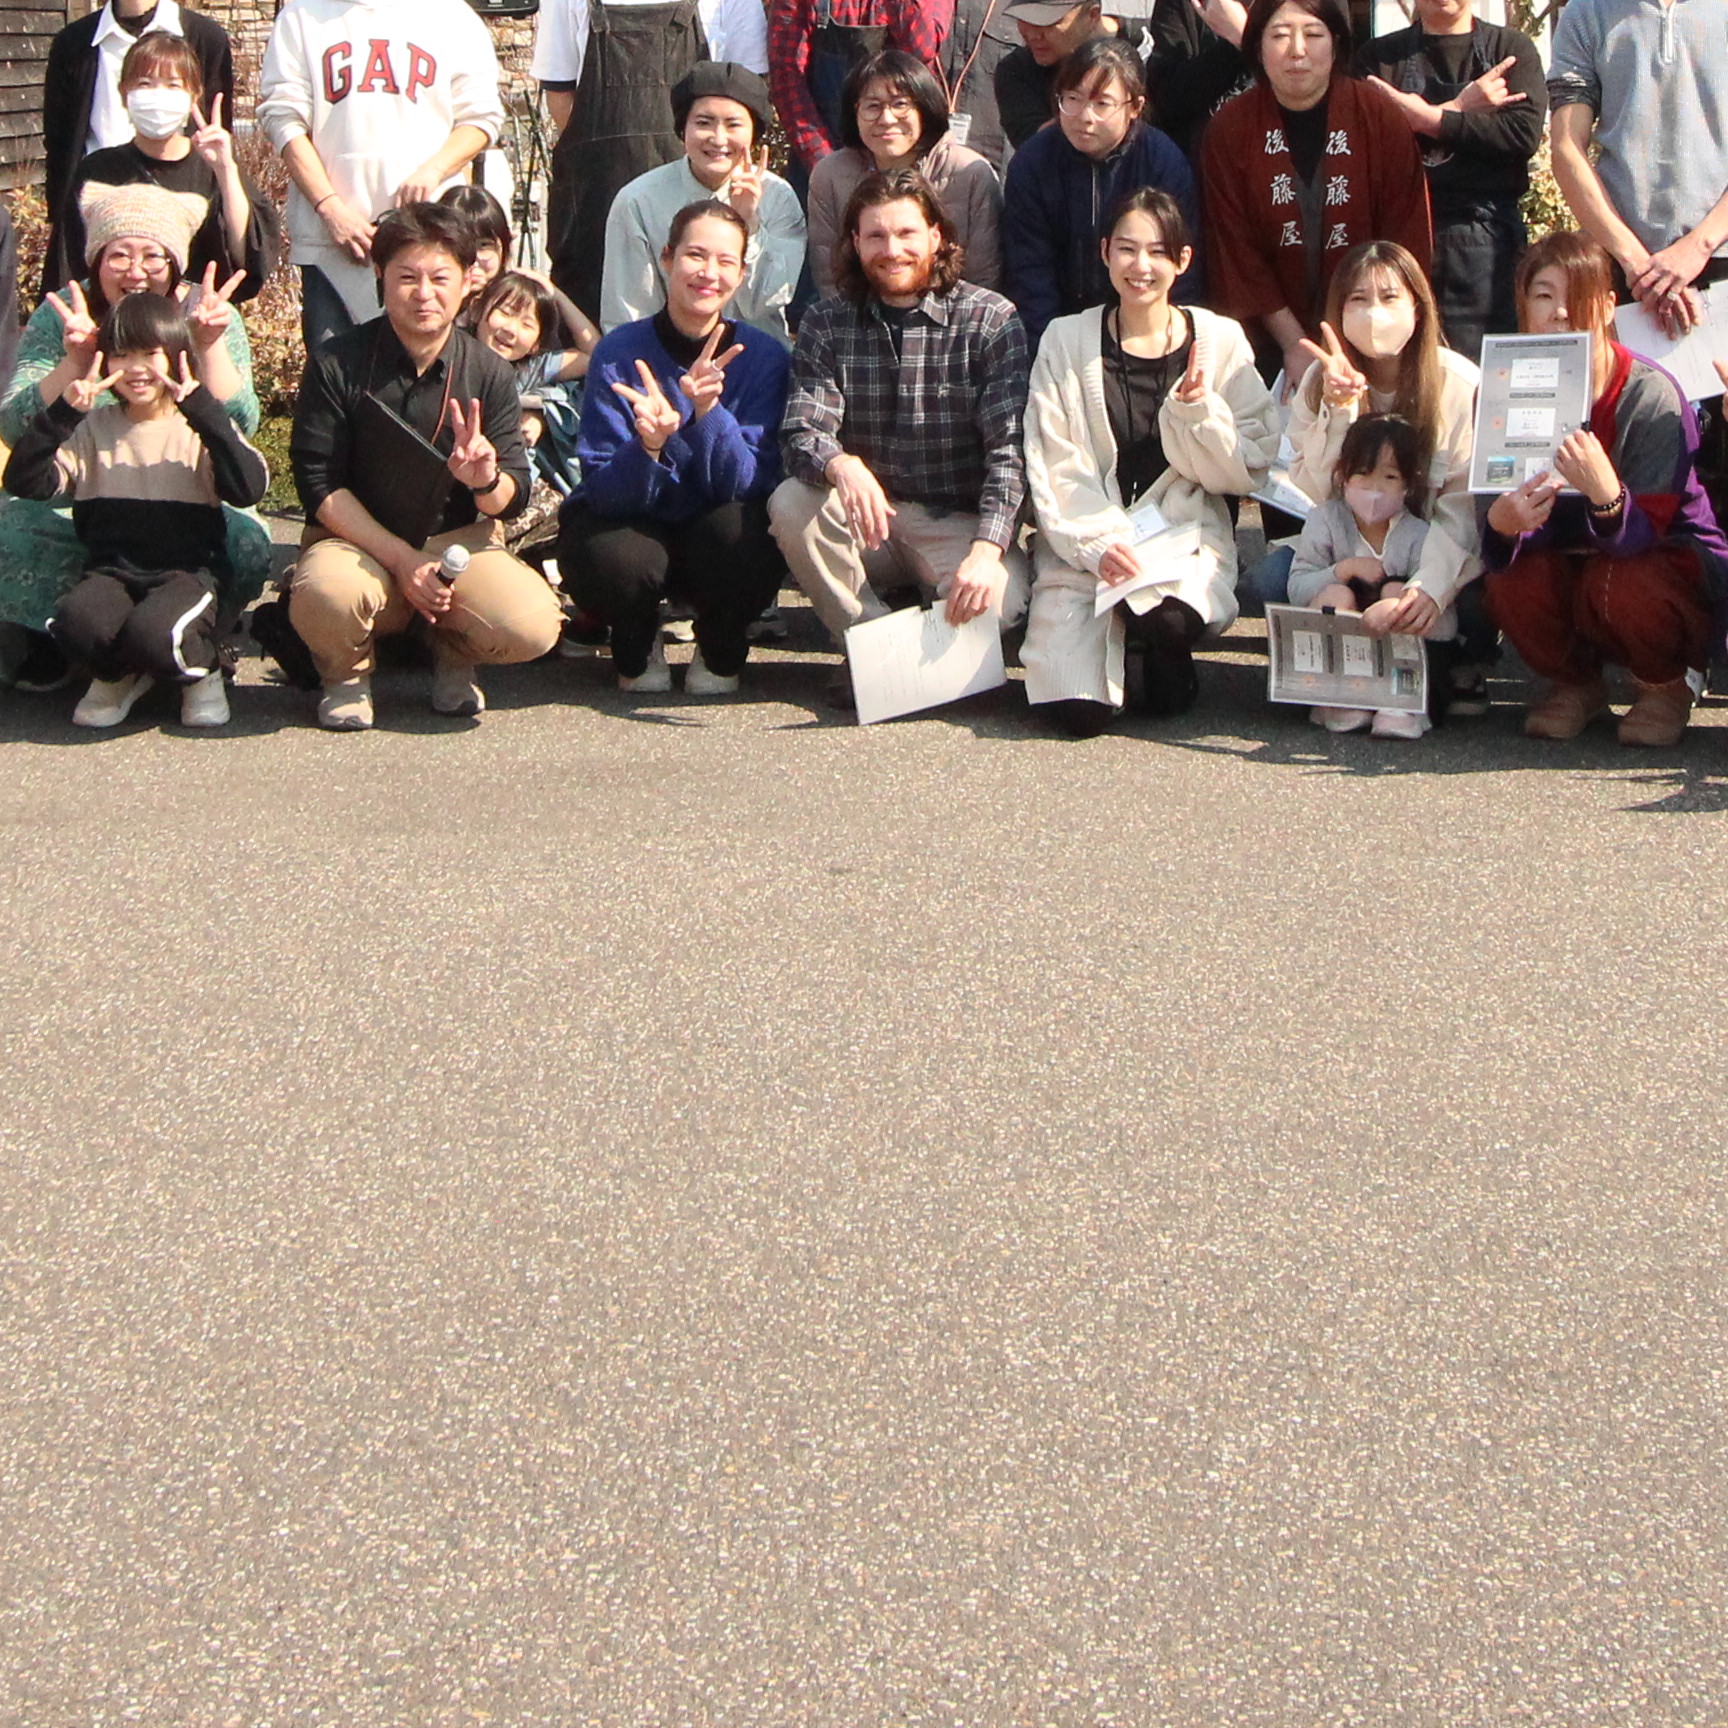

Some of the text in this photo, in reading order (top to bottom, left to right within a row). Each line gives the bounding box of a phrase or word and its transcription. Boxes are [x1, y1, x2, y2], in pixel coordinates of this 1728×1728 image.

[321, 37, 438, 106] GAP
[1264, 128, 1303, 247] 後藤屋
[1325, 129, 1352, 250] 後藤屋
